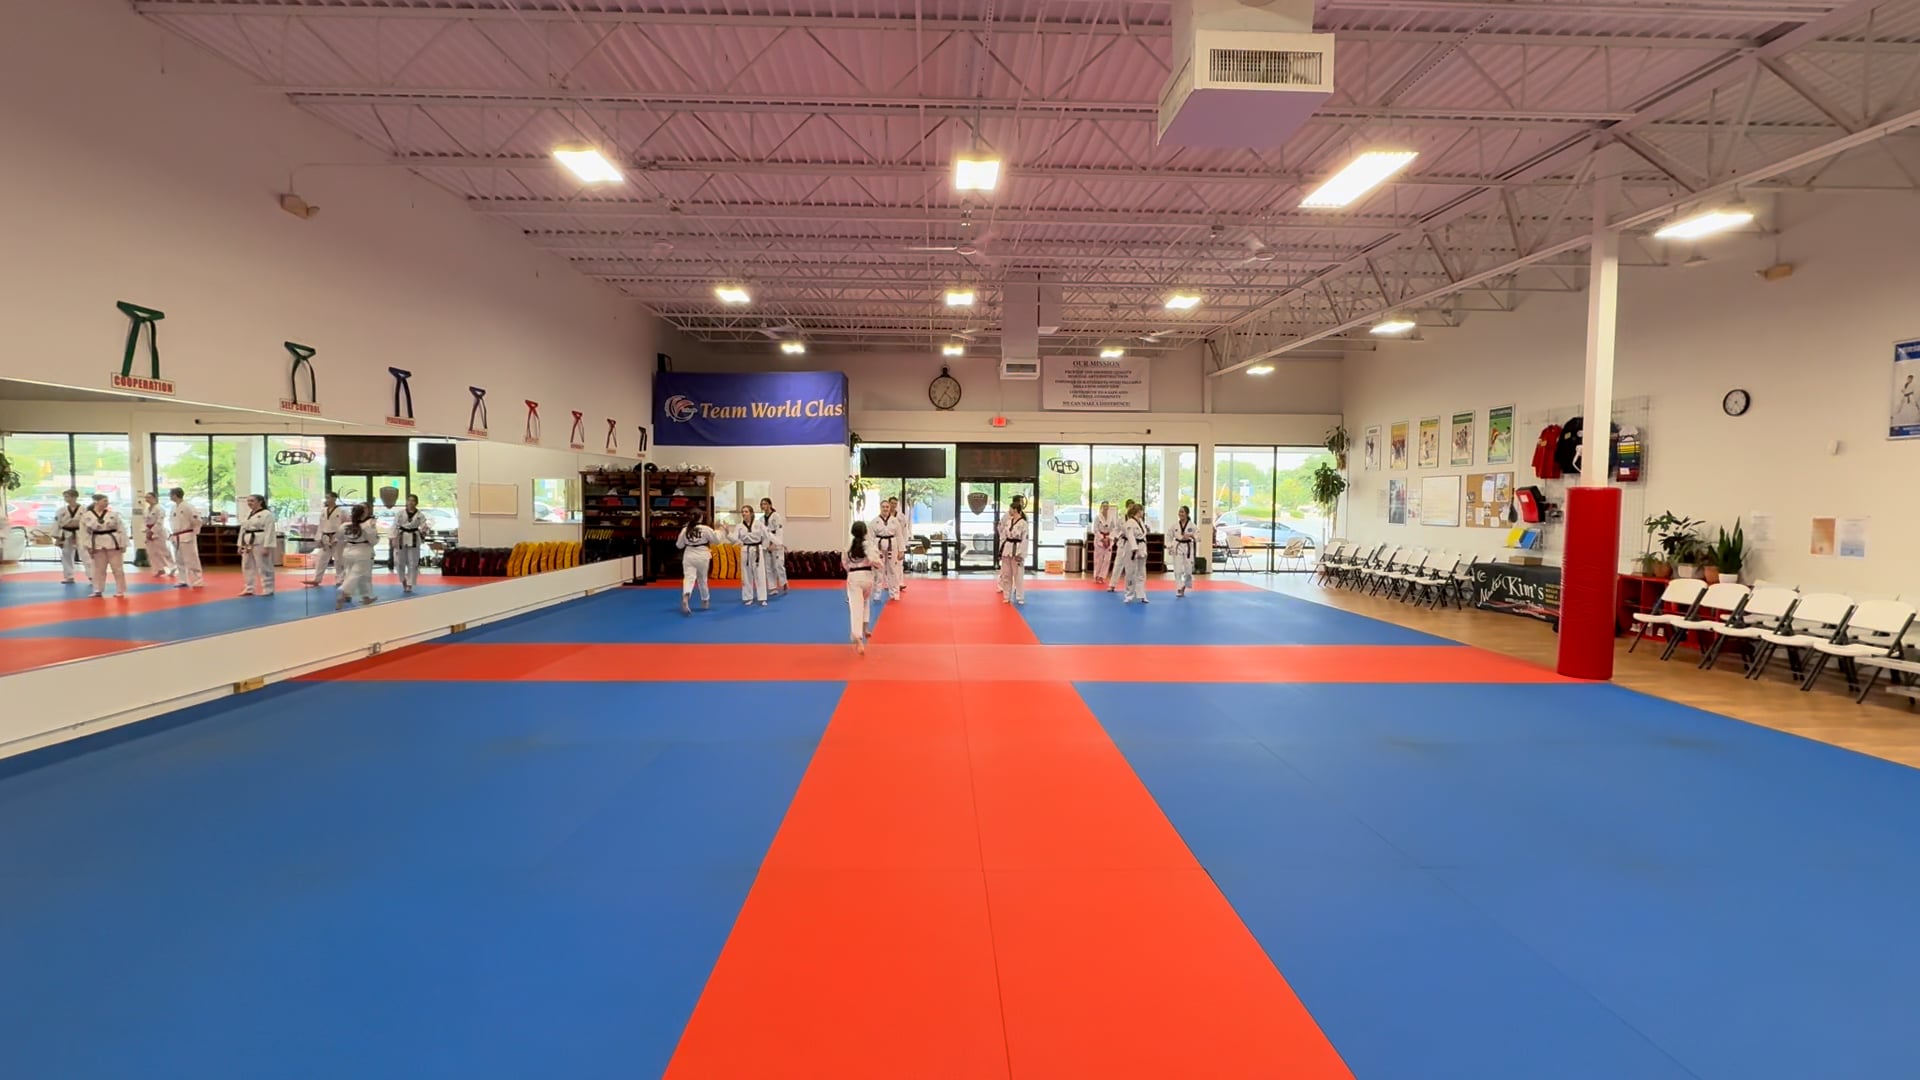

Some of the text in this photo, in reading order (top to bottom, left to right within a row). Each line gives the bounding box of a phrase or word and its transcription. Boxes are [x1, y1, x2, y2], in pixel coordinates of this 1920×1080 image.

[1072, 360, 1120, 368] OUR MISSION
[114, 375, 173, 394] COOPERATION
[295, 402, 321, 414] CONTROL
[700, 402, 747, 419] Team
[751, 399, 802, 418] World
[276, 450, 316, 466] OPEN
[1502, 575, 1544, 600] Kim's
